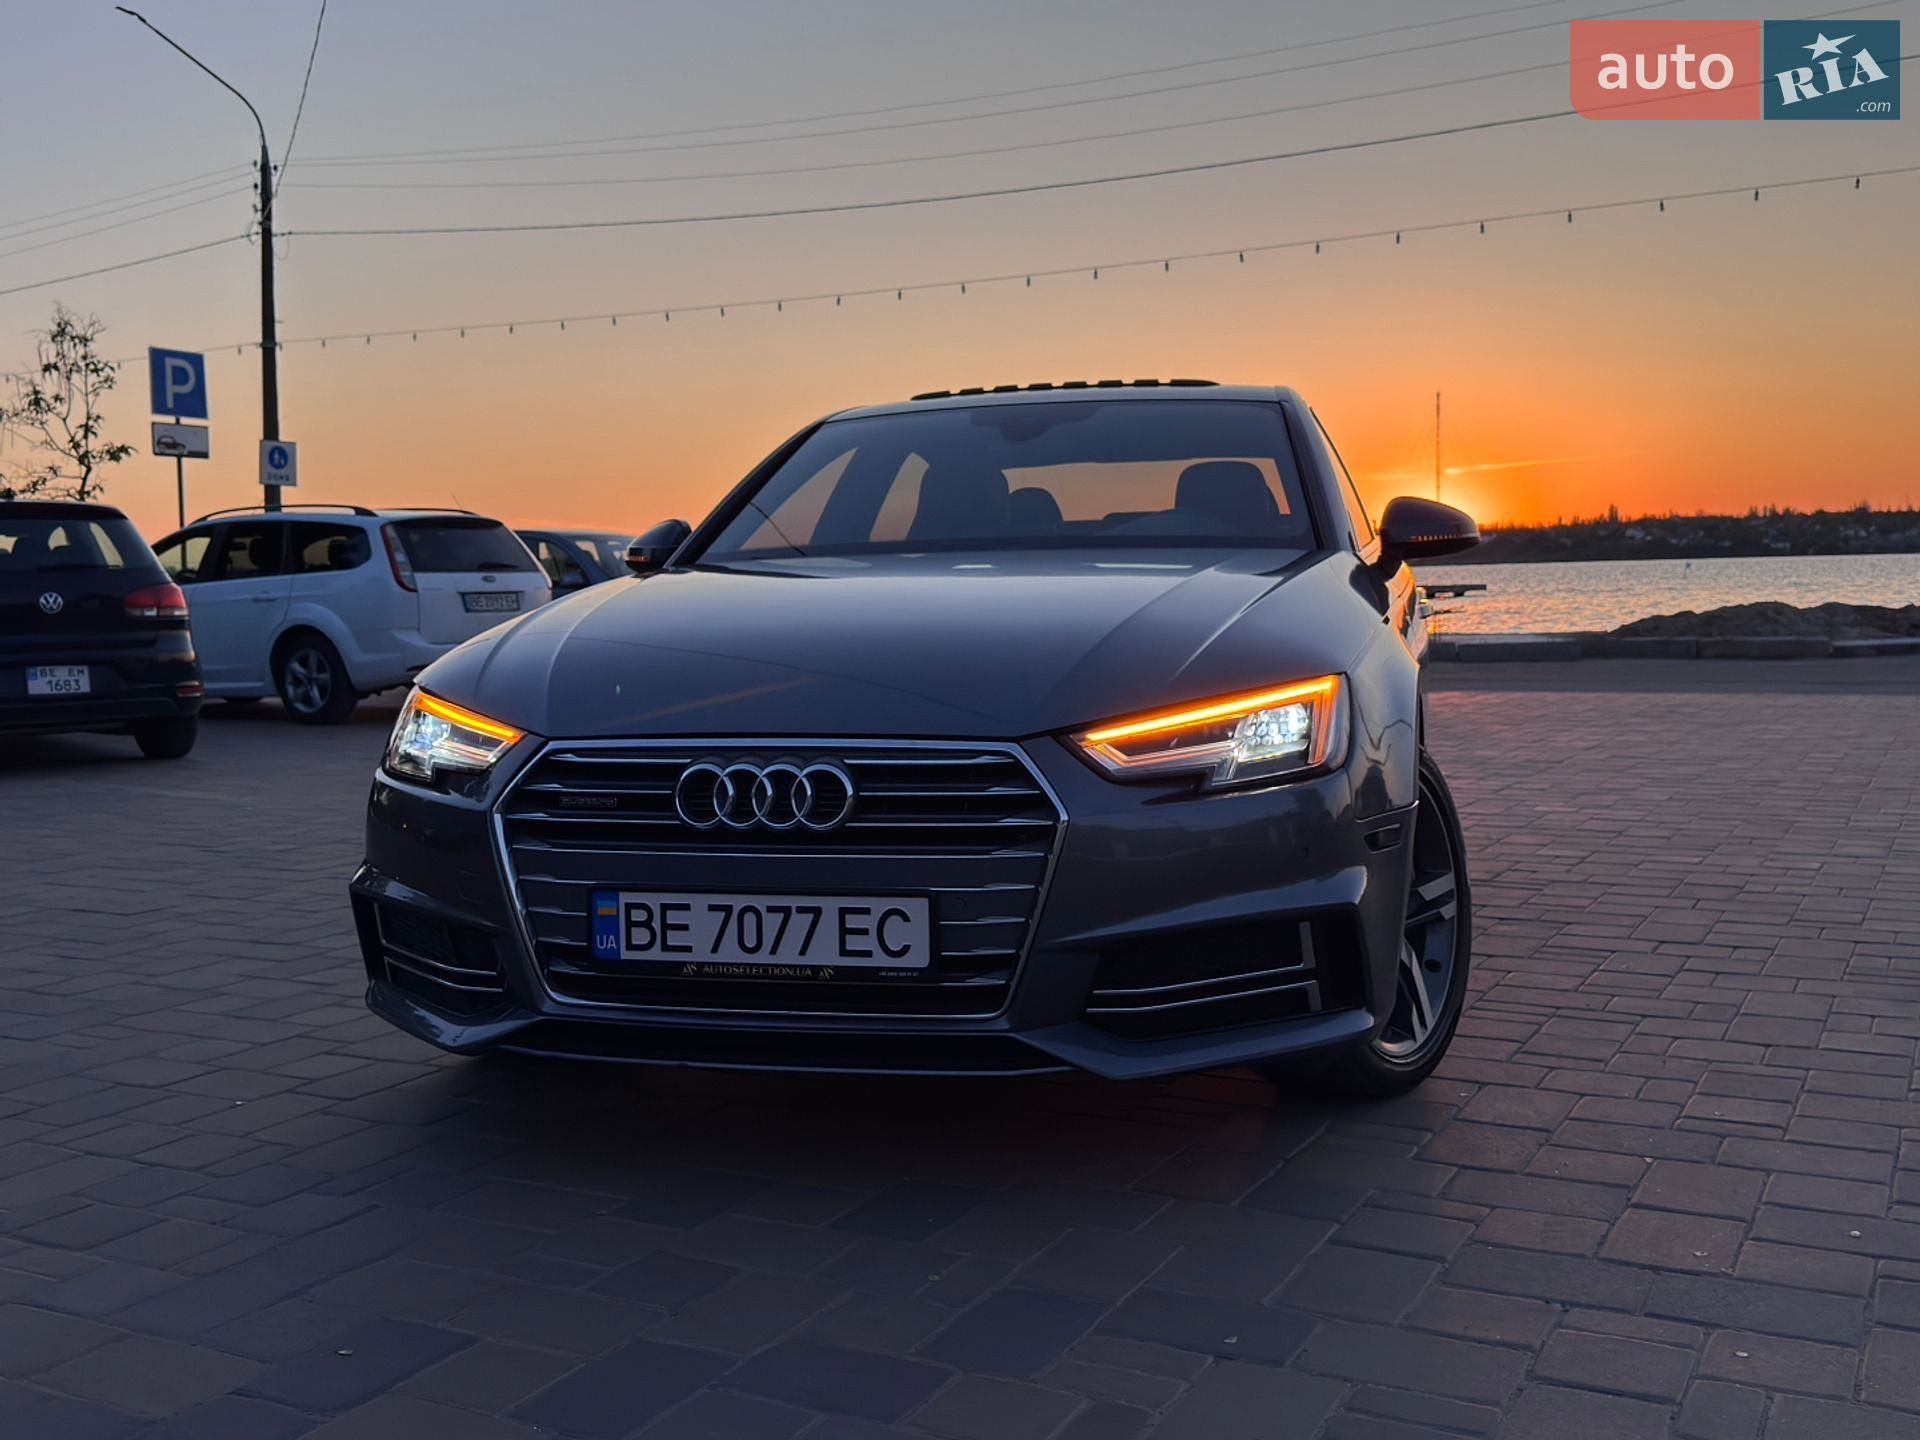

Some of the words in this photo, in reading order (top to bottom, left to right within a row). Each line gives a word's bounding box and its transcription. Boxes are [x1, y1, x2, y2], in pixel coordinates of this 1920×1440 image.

[164, 356, 197, 409] P
[47, 679, 81, 692] 1683
[623, 901, 694, 953] BE
[707, 904, 823, 956] 7077
[837, 906, 912, 958] EC
[596, 935, 618, 950] UA
[702, 965, 813, 978] AUTOSELECTION.UA
